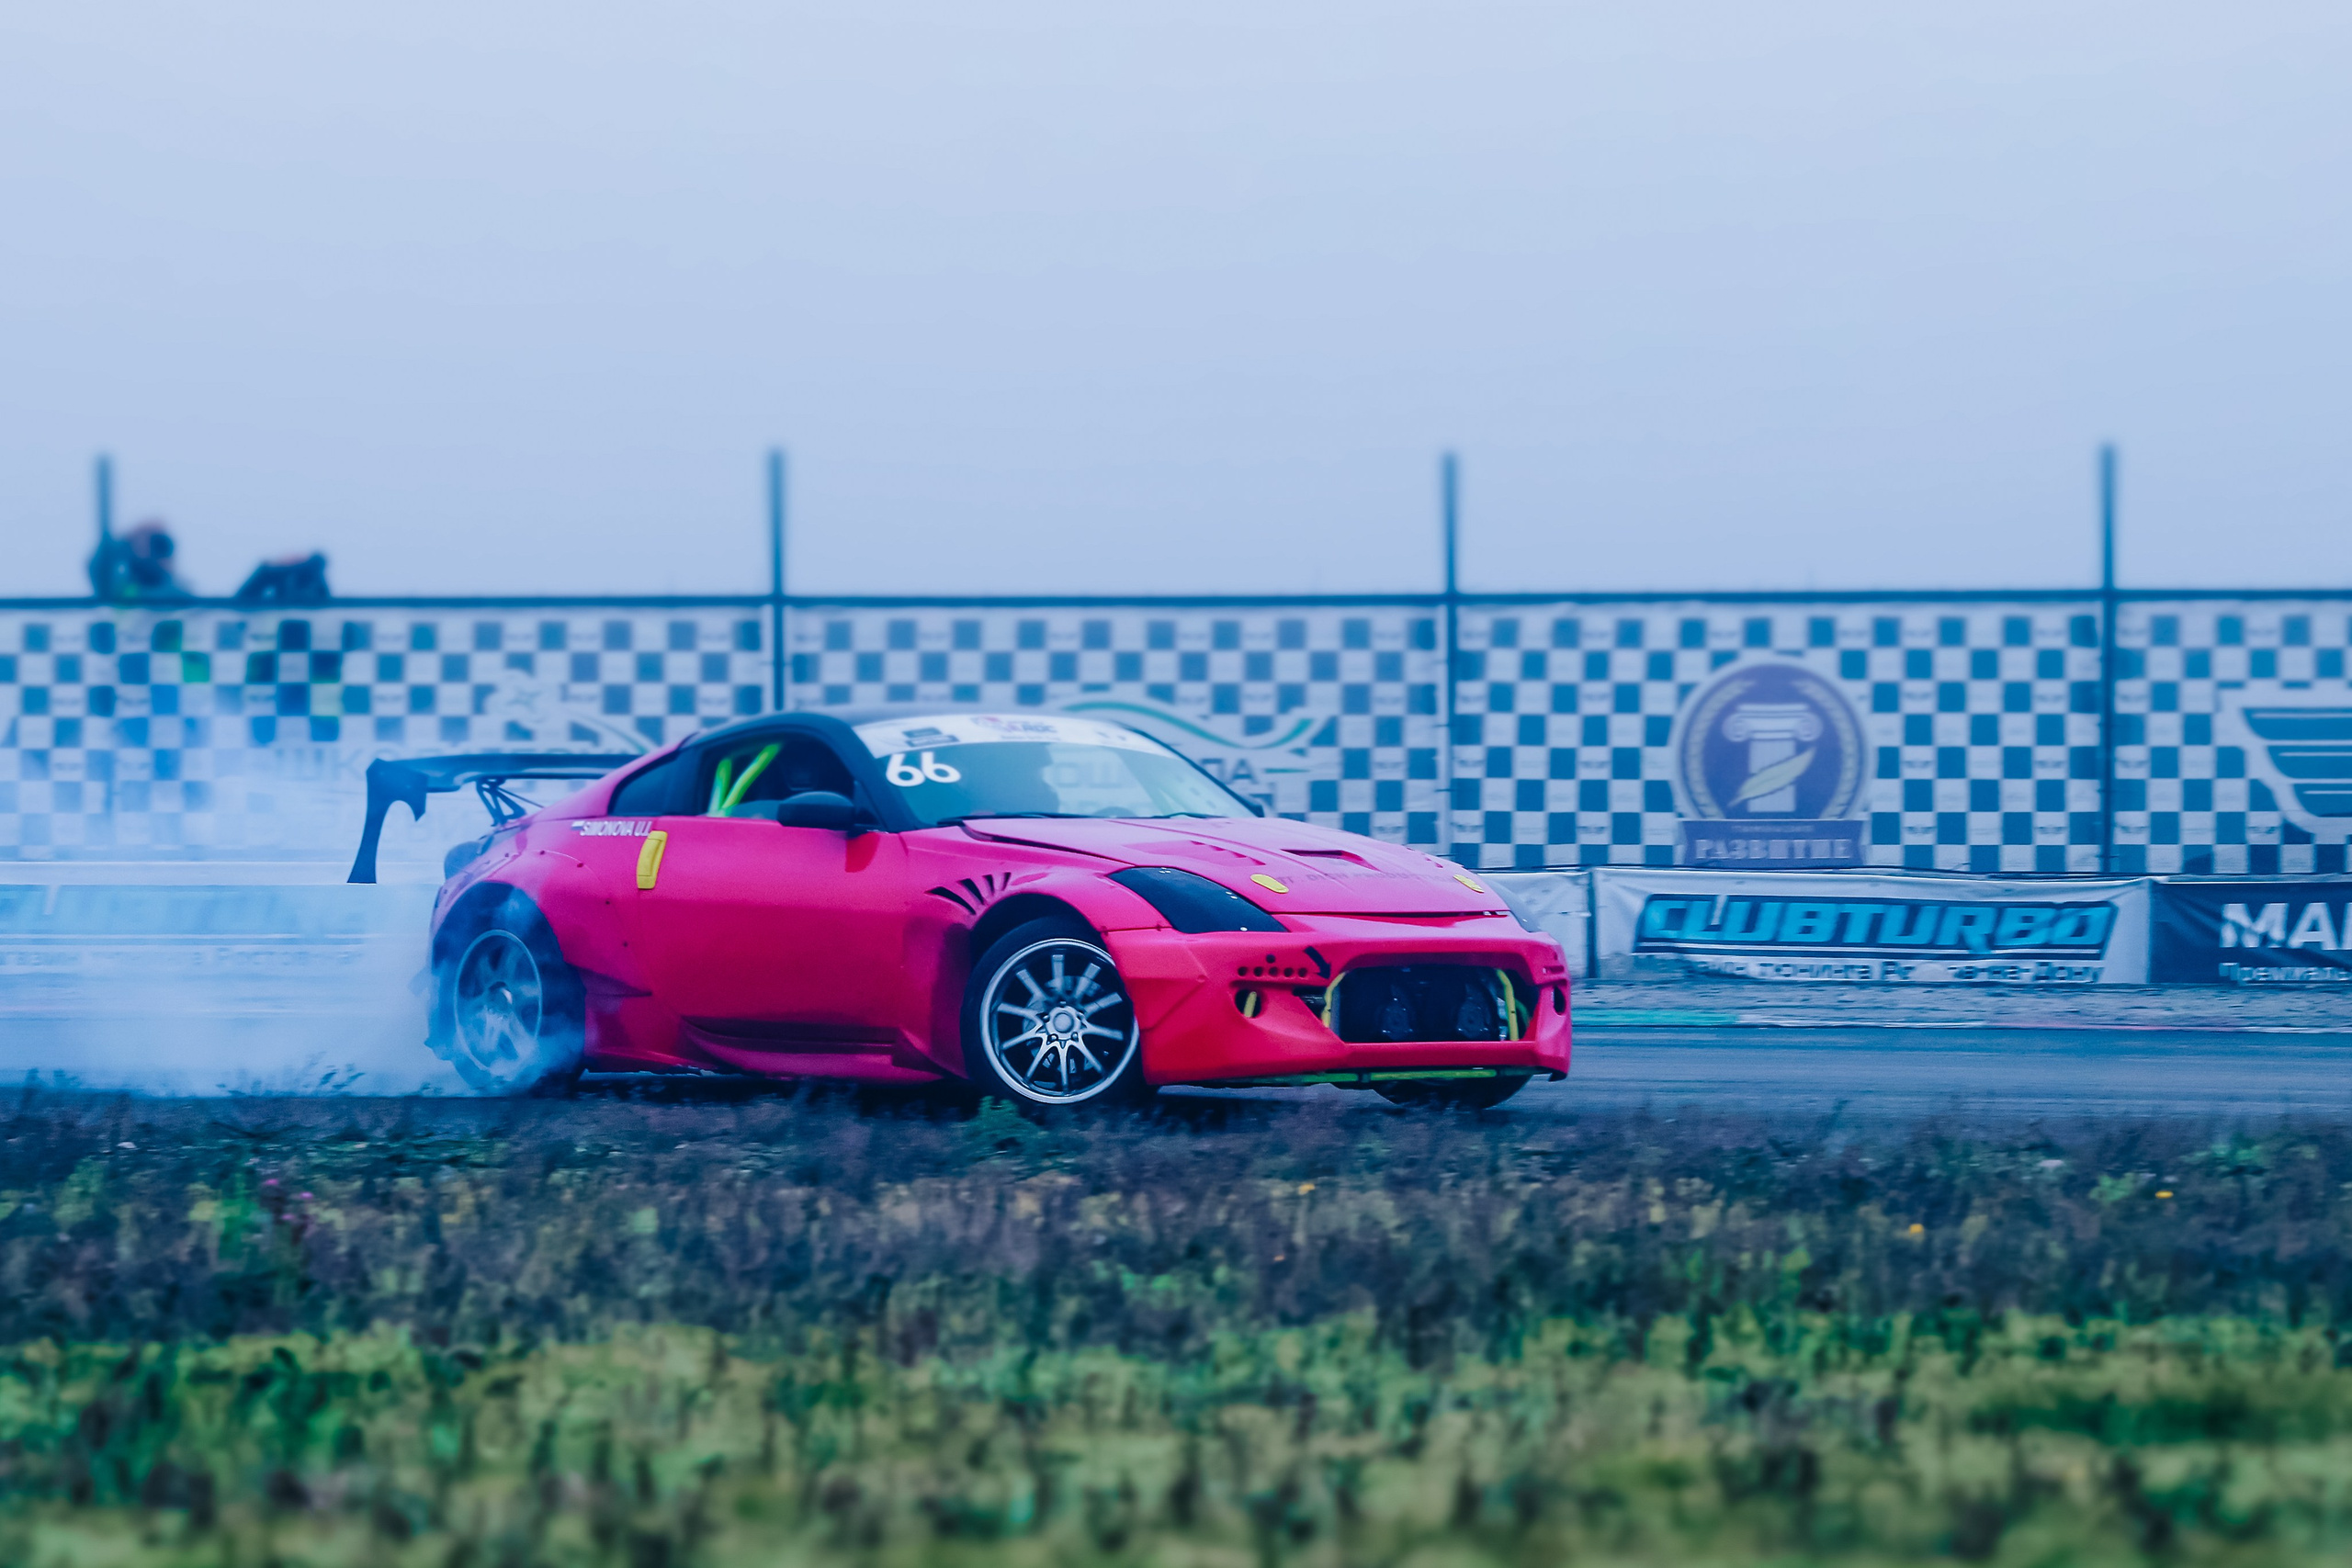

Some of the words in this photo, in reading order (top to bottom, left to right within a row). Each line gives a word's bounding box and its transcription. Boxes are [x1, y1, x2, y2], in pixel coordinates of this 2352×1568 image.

[886, 751, 960, 786] 66
[580, 821, 634, 836] SIMONOVA
[1696, 840, 1851, 859] РАЗВИТИЕ
[1648, 899, 2108, 950] CLUBTURBO
[1883, 961, 2104, 983] Ров-на-Дону
